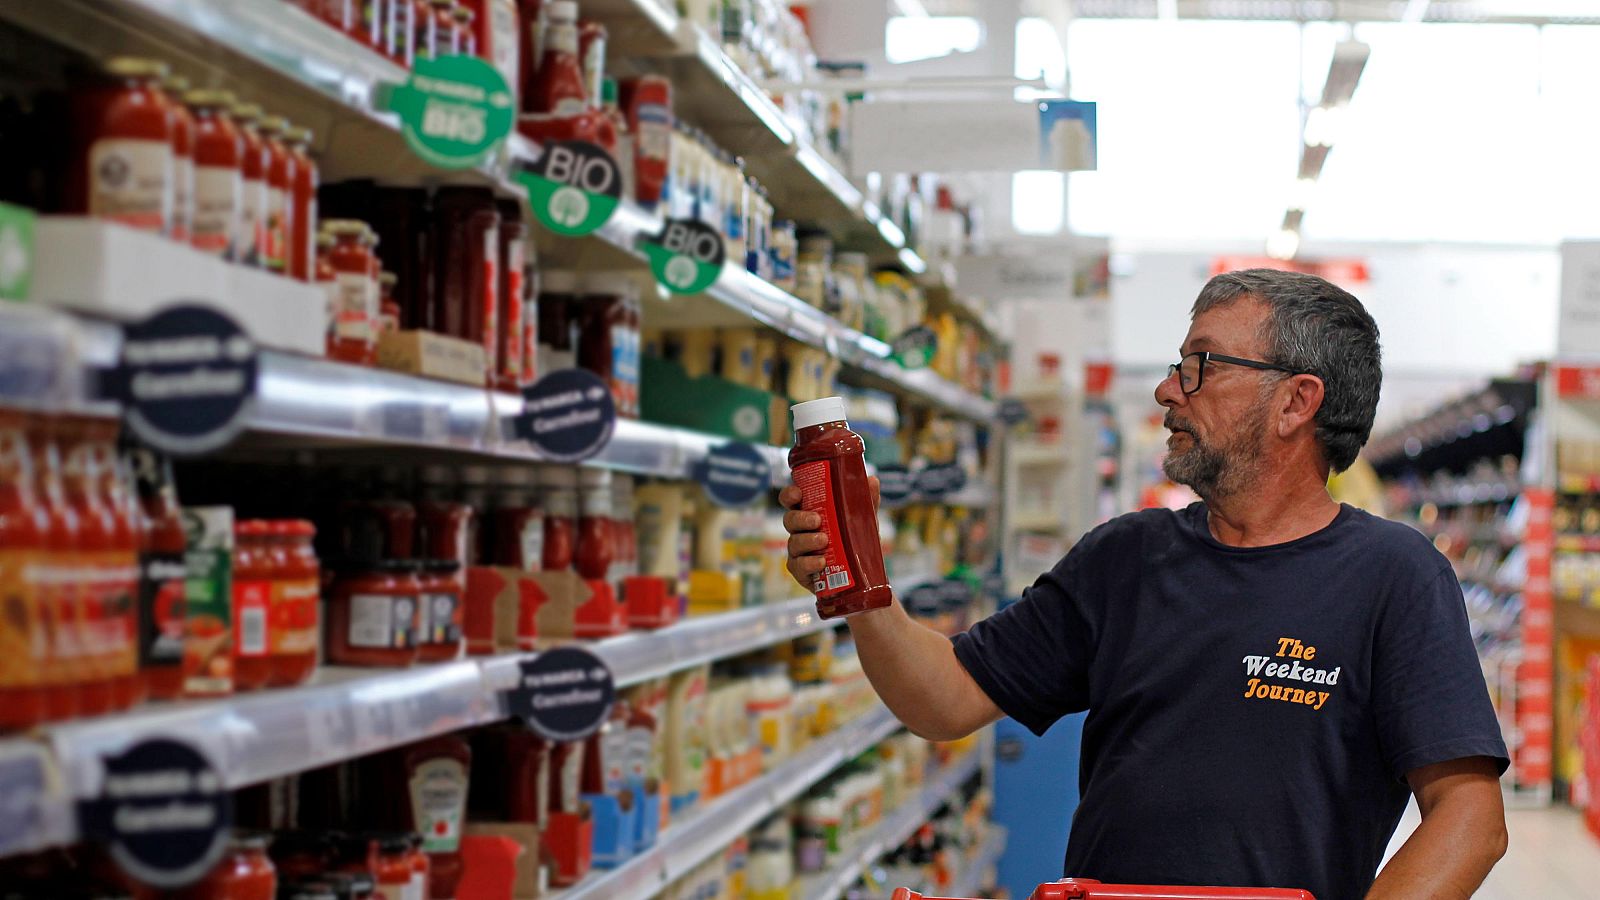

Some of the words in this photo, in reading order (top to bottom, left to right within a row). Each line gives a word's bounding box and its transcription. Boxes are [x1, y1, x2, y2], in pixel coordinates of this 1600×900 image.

[422, 107, 487, 144] BIO
[545, 146, 613, 194] BIO
[663, 224, 719, 263] BIO
[1275, 637, 1316, 660] The
[1242, 655, 1341, 685] Weekend
[1244, 678, 1330, 710] Journey
